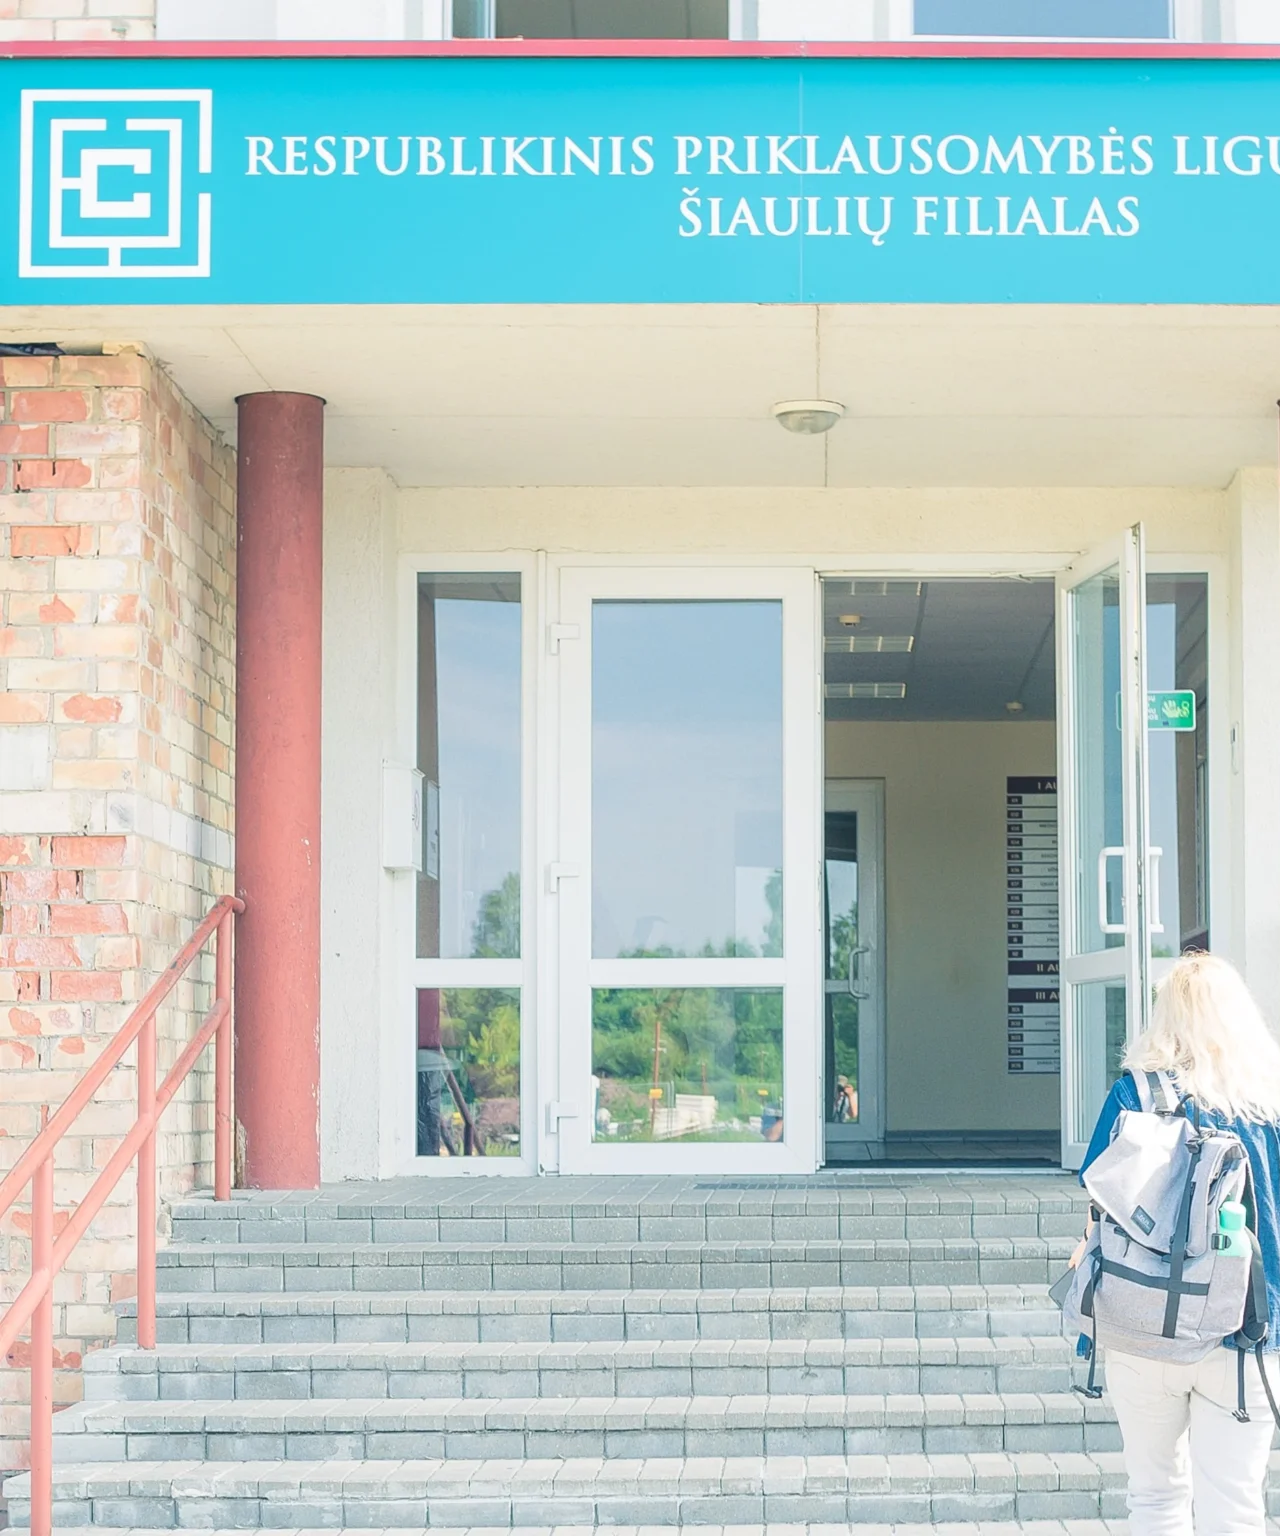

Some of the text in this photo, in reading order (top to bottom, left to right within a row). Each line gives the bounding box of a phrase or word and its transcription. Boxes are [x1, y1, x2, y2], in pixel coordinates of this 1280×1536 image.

[245, 135, 655, 176] RESPUBLIKINIS
[673, 126, 1154, 176] PRIKLAUSOMYBĖS
[678, 187, 1140, 247] ŠIAULIŲ FILIALAS
